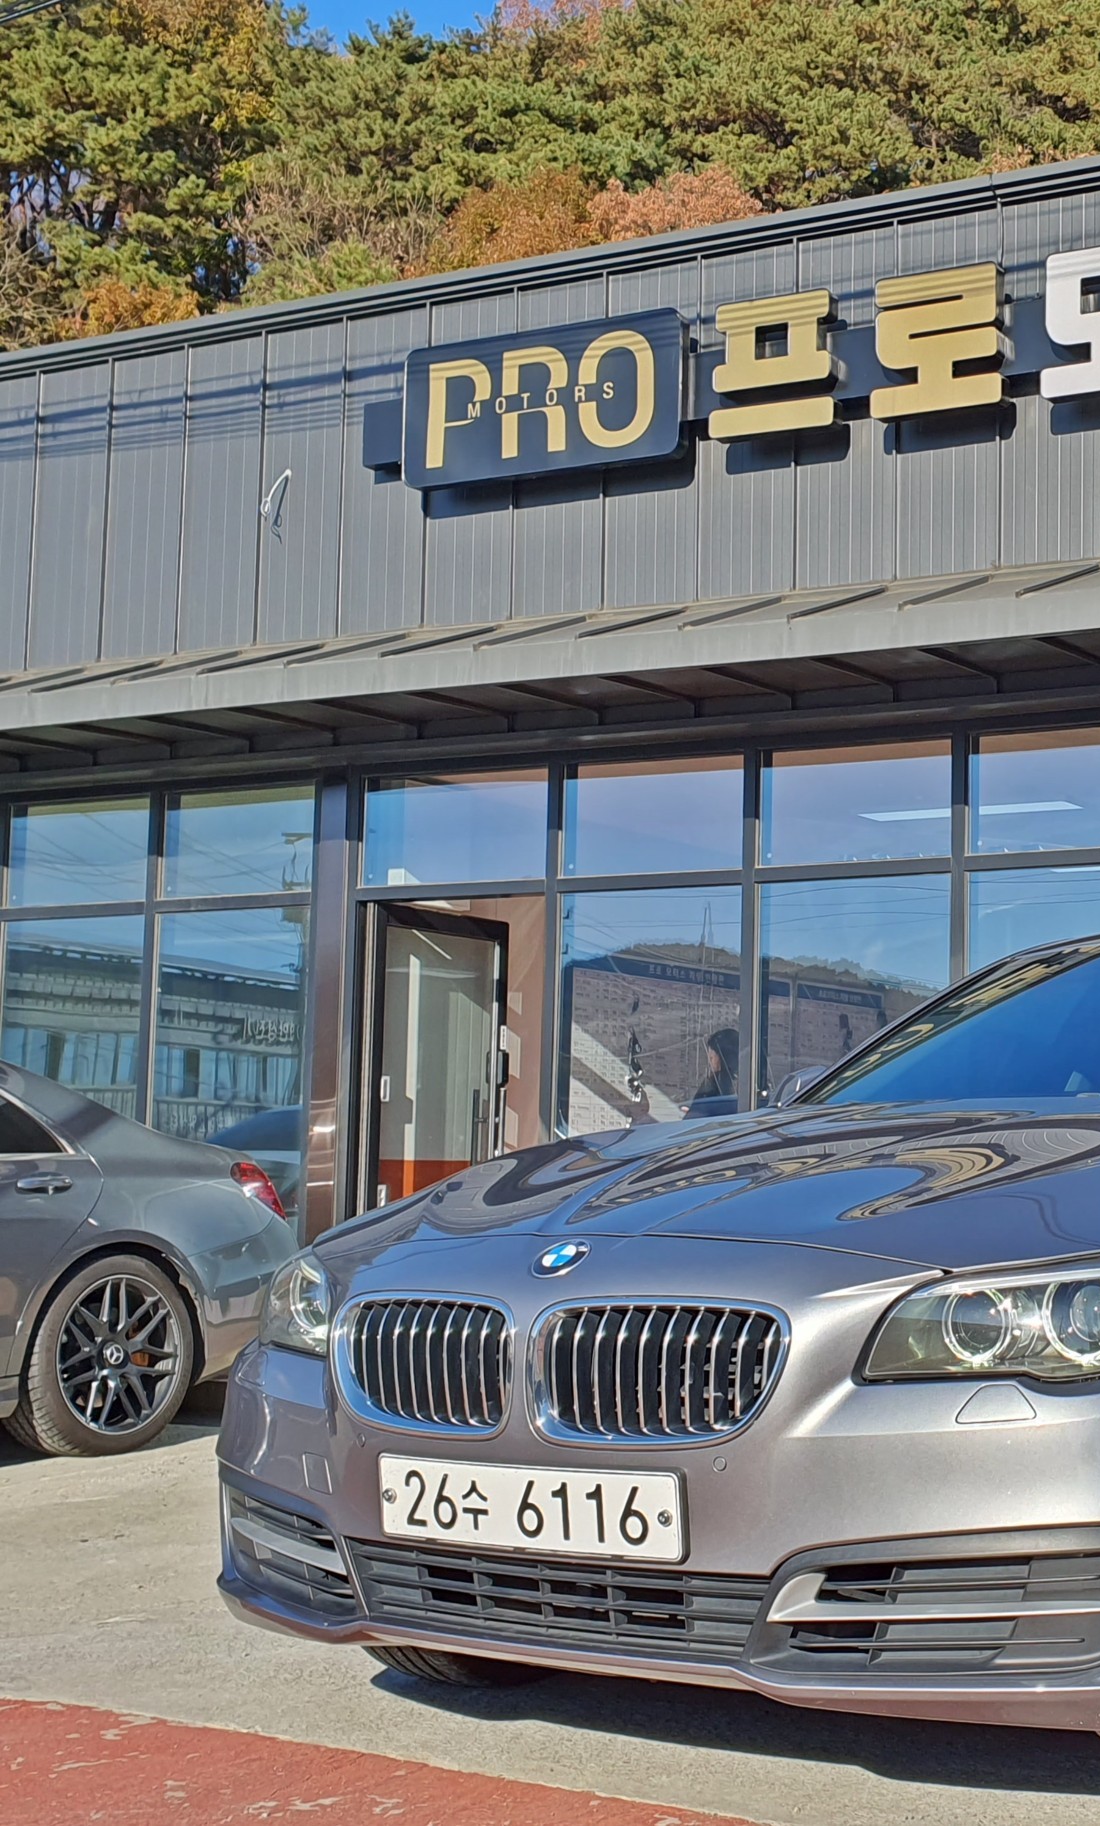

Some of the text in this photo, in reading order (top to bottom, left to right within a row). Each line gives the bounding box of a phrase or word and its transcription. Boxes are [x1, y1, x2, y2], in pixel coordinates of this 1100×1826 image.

[424, 328, 655, 470] PRO
[466, 380, 615, 419] MOTORS
[404, 1469, 649, 1546] 26수 6116
